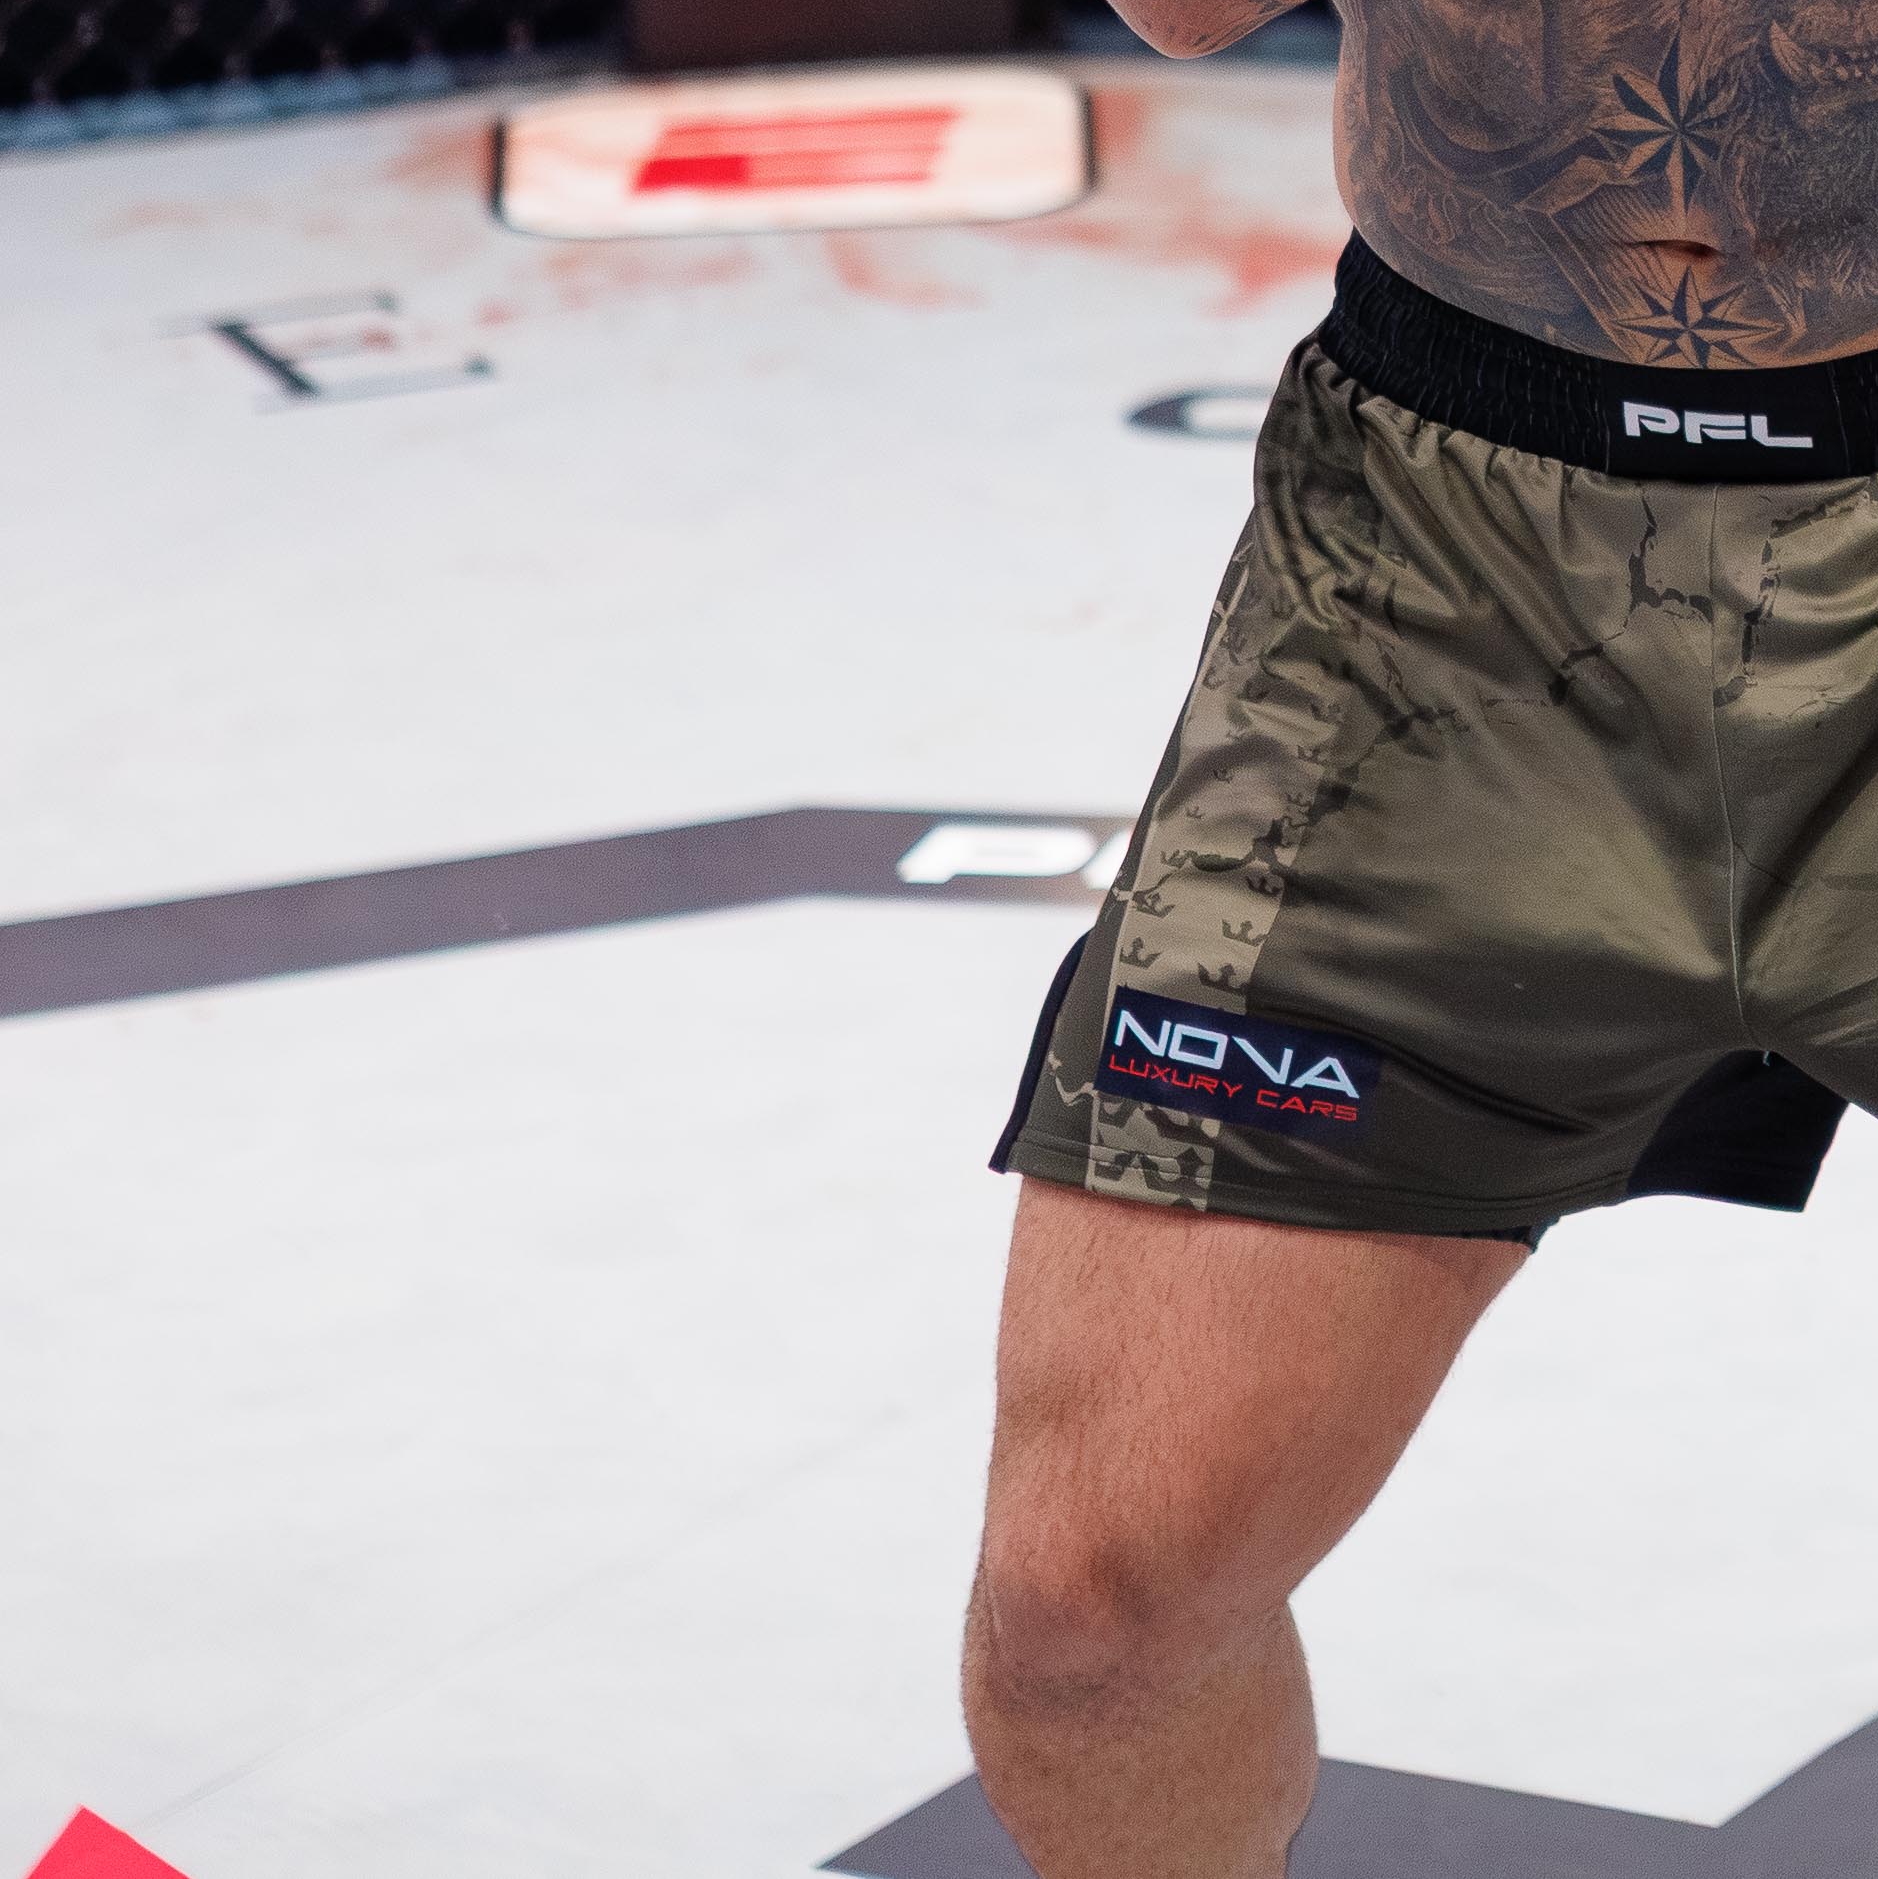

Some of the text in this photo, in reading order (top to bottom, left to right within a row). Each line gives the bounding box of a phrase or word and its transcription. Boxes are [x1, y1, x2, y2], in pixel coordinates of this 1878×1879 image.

[1623, 401, 1814, 449] PFL
[1108, 1053, 1359, 1122] LUXURY CARS
[1114, 1008, 1361, 1099] NOVA
